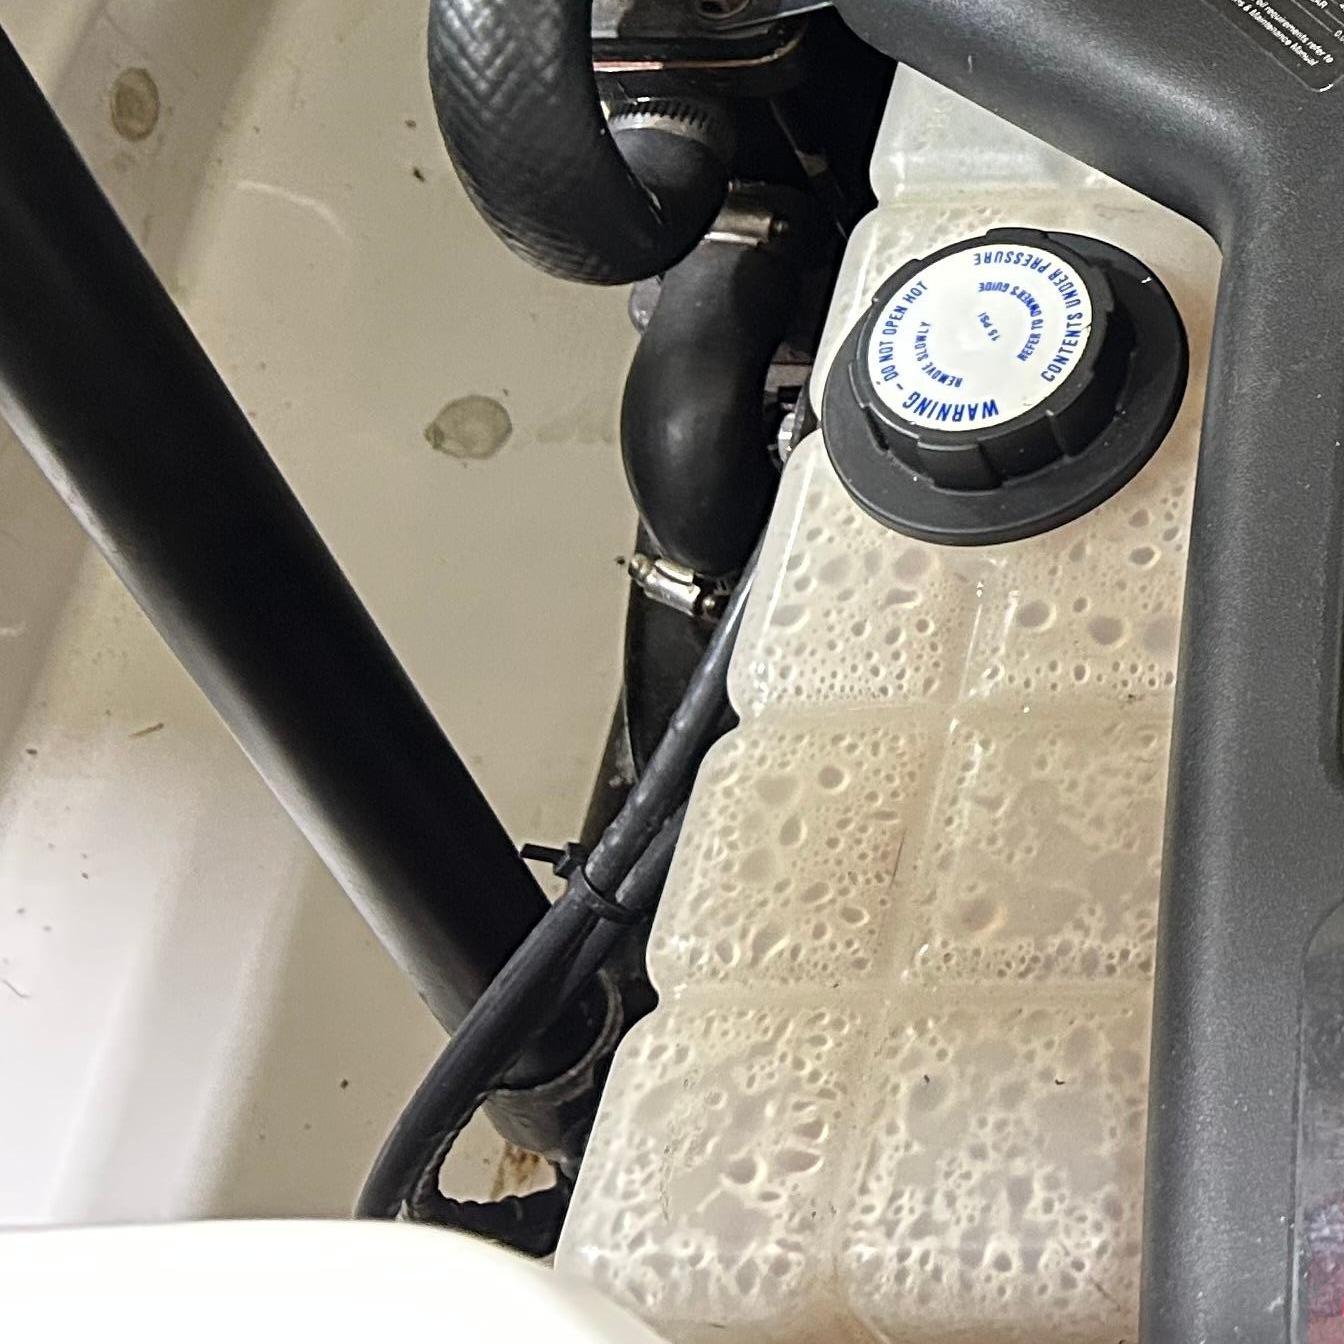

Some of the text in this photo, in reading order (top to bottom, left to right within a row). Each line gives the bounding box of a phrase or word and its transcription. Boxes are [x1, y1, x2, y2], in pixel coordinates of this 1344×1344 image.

[1323, 54, 1335, 63] to
[902, 280, 928, 305] HOT
[978, 281, 1011, 293] GUIDE
[882, 305, 908, 336] OPEN
[973, 250, 1084, 383] CONTENTS UNDER PRESSURE
[977, 311, 1001, 342] 15 PSI
[1031, 318, 1044, 332] TO
[879, 340, 894, 364] NOT
[914, 321, 963, 388] REMOVE SLOWLY
[1017, 333, 1041, 362] REFER
[880, 364, 899, 382] DO
[902, 390, 1000, 422] WARNING
